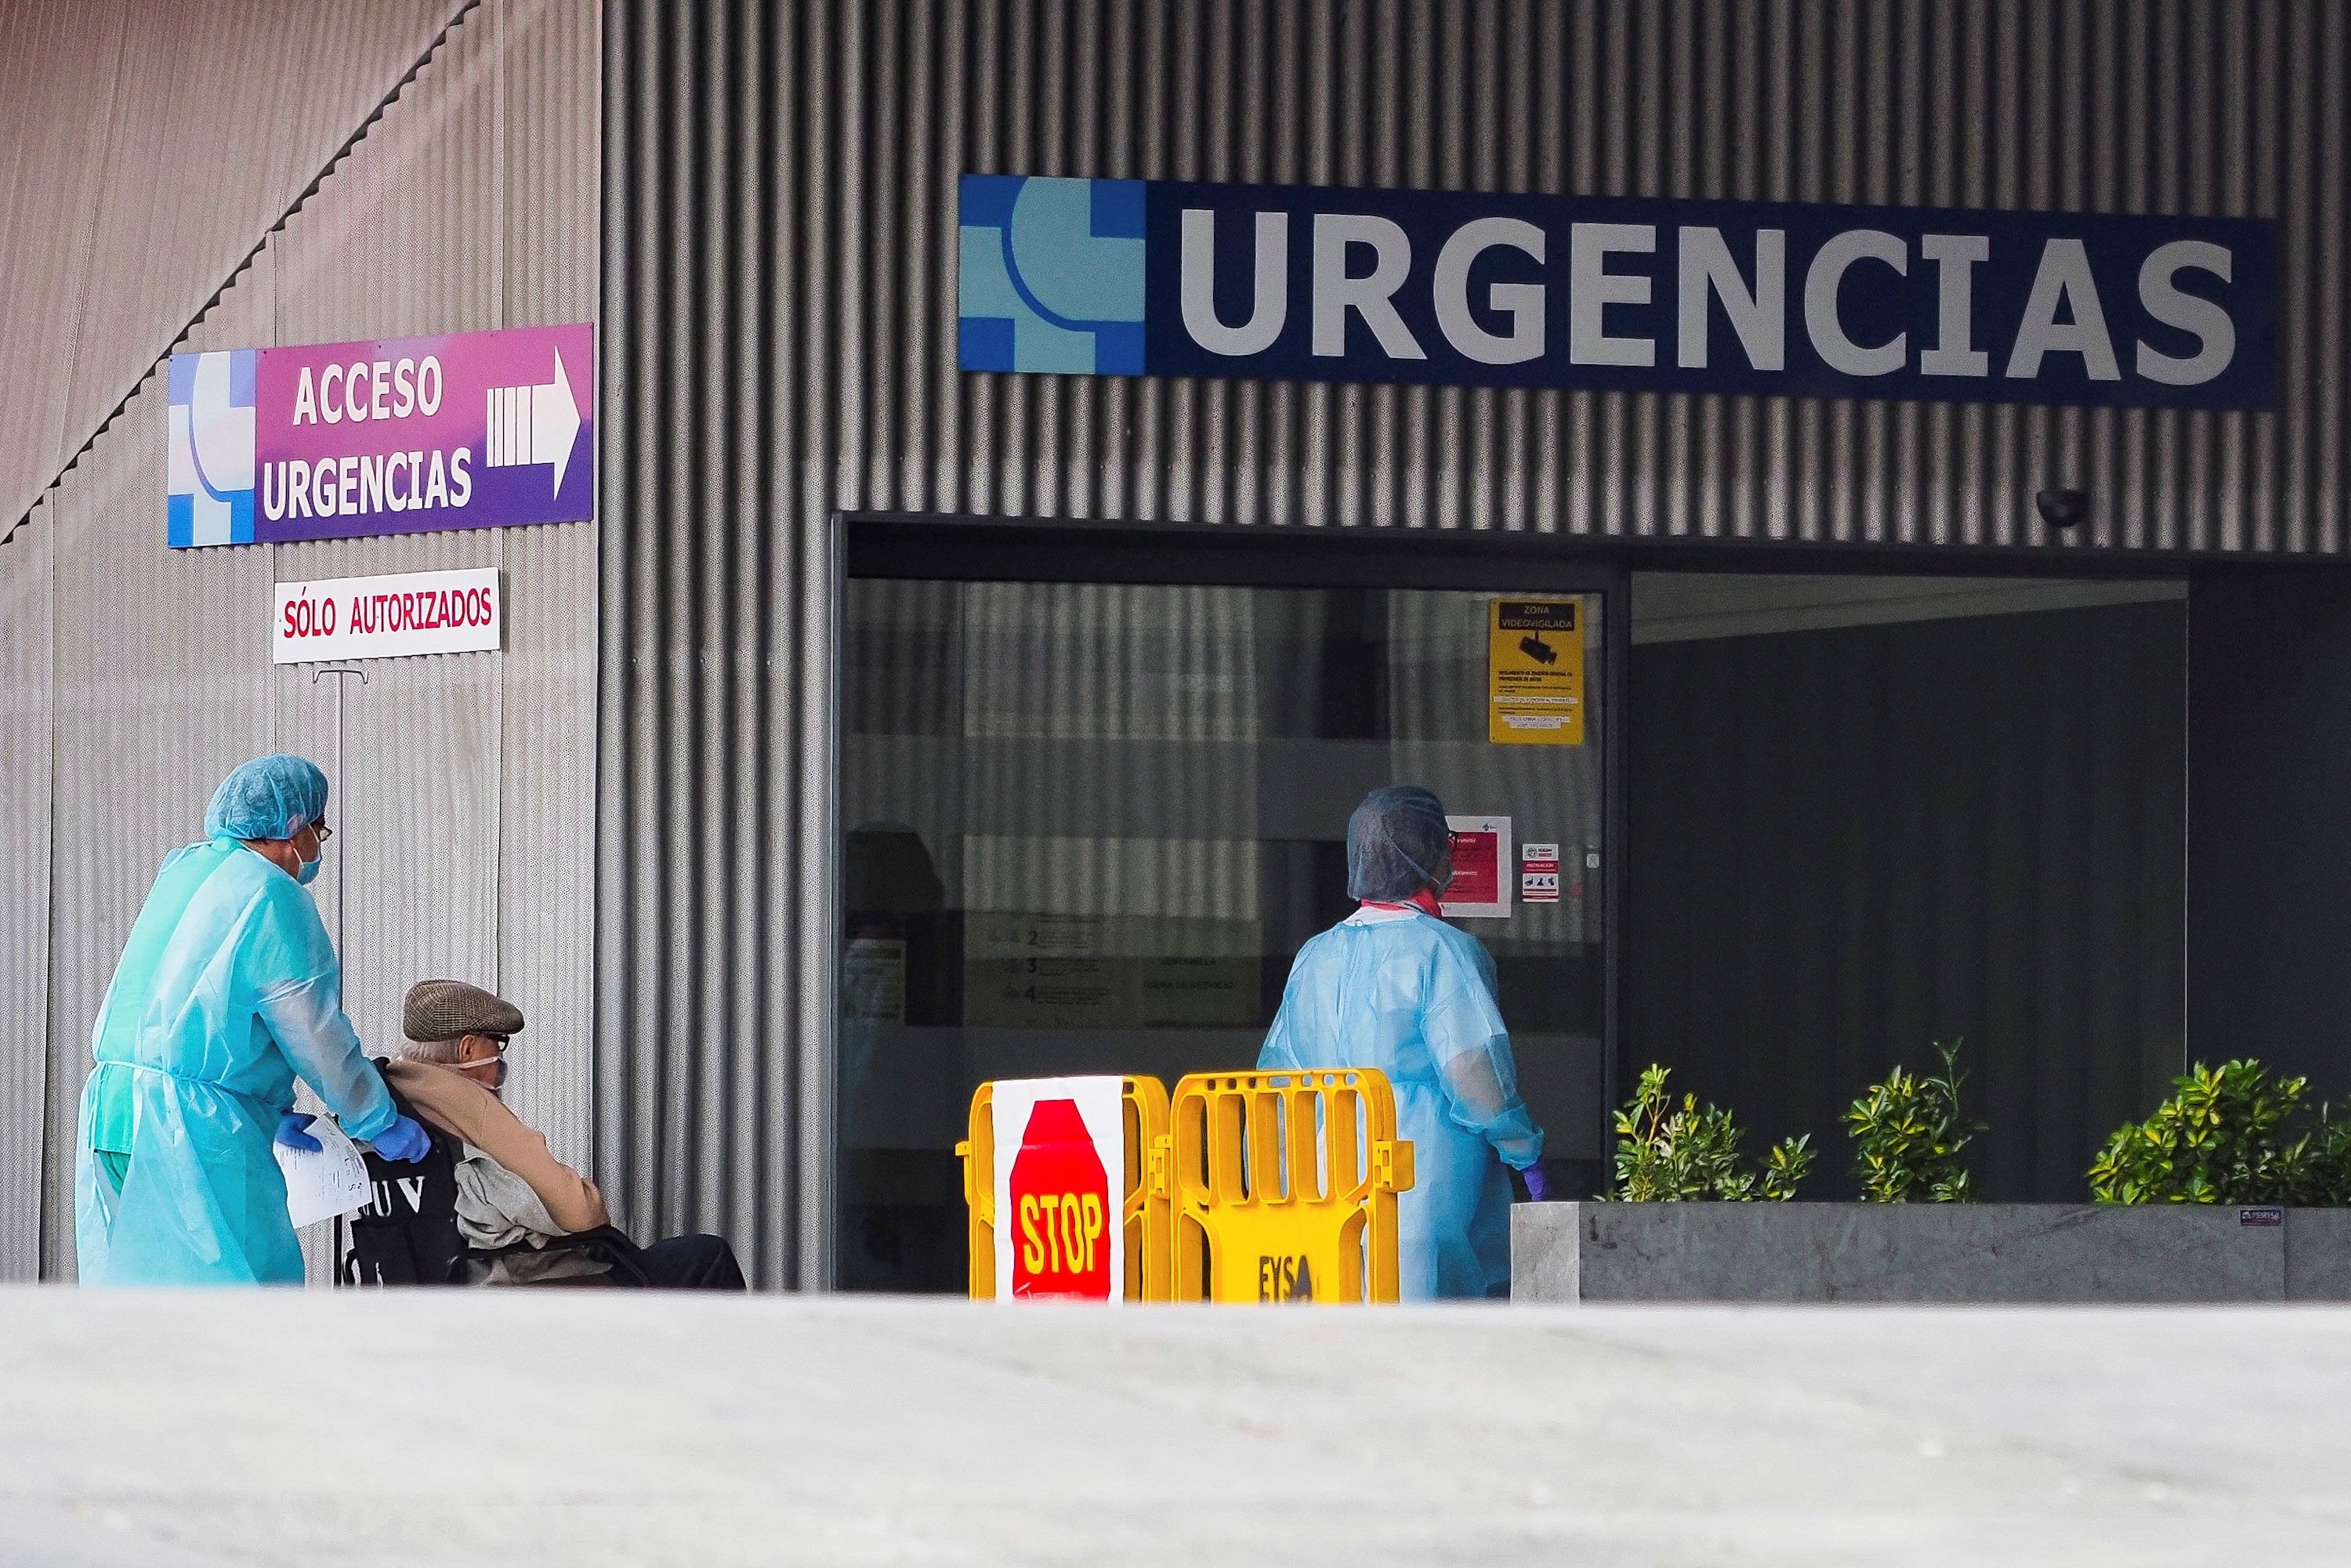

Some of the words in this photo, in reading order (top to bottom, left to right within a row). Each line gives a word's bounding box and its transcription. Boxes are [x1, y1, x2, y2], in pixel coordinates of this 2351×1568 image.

[1180, 207, 2236, 386] URGENCIAS
[292, 355, 443, 425] ACCESO
[263, 446, 472, 521] URGENCIAS
[283, 586, 336, 639] SÓLO
[350, 587, 491, 636] AUTORIZADOS
[1502, 618, 1573, 628] VIDEOVIGILADA
[1523, 605, 1550, 615] ZONA
[1027, 931, 1038, 945] 2
[1027, 958, 1038, 973] 3
[1024, 986, 1036, 1001] 4
[1020, 1193, 1103, 1275] STOP
[1259, 1255, 1311, 1304] EYSA
